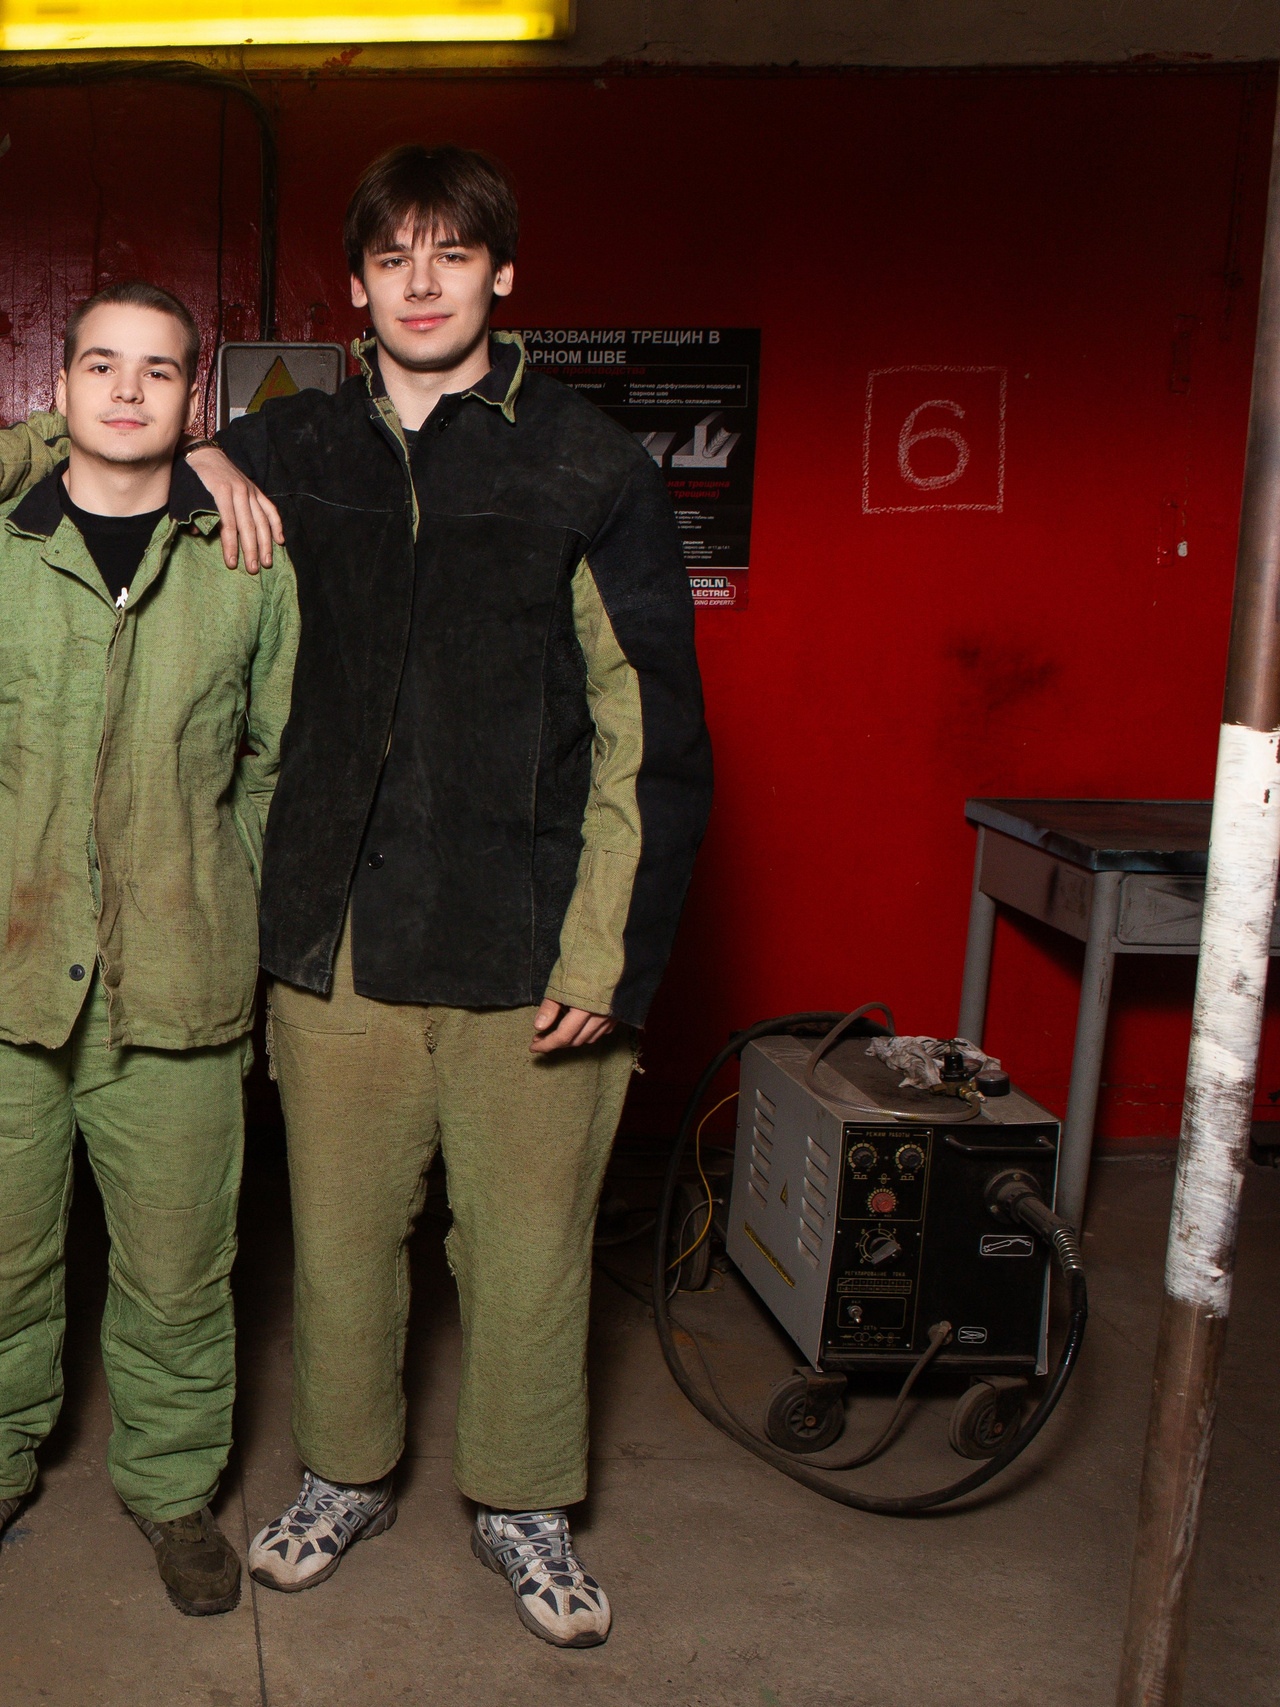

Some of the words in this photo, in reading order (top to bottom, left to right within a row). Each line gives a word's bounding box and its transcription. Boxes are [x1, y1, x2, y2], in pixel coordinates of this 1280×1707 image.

[501, 330, 625, 344] РАЗОВАНИЯ
[630, 330, 703, 347] ТРЕЩИН
[708, 330, 721, 344] В
[587, 350, 627, 364] ШВЕ
[628, 397, 655, 405] Быстрая
[897, 399, 970, 491] 6
[687, 480, 730, 490] трещина
[691, 589, 730, 597] LECTRIC
